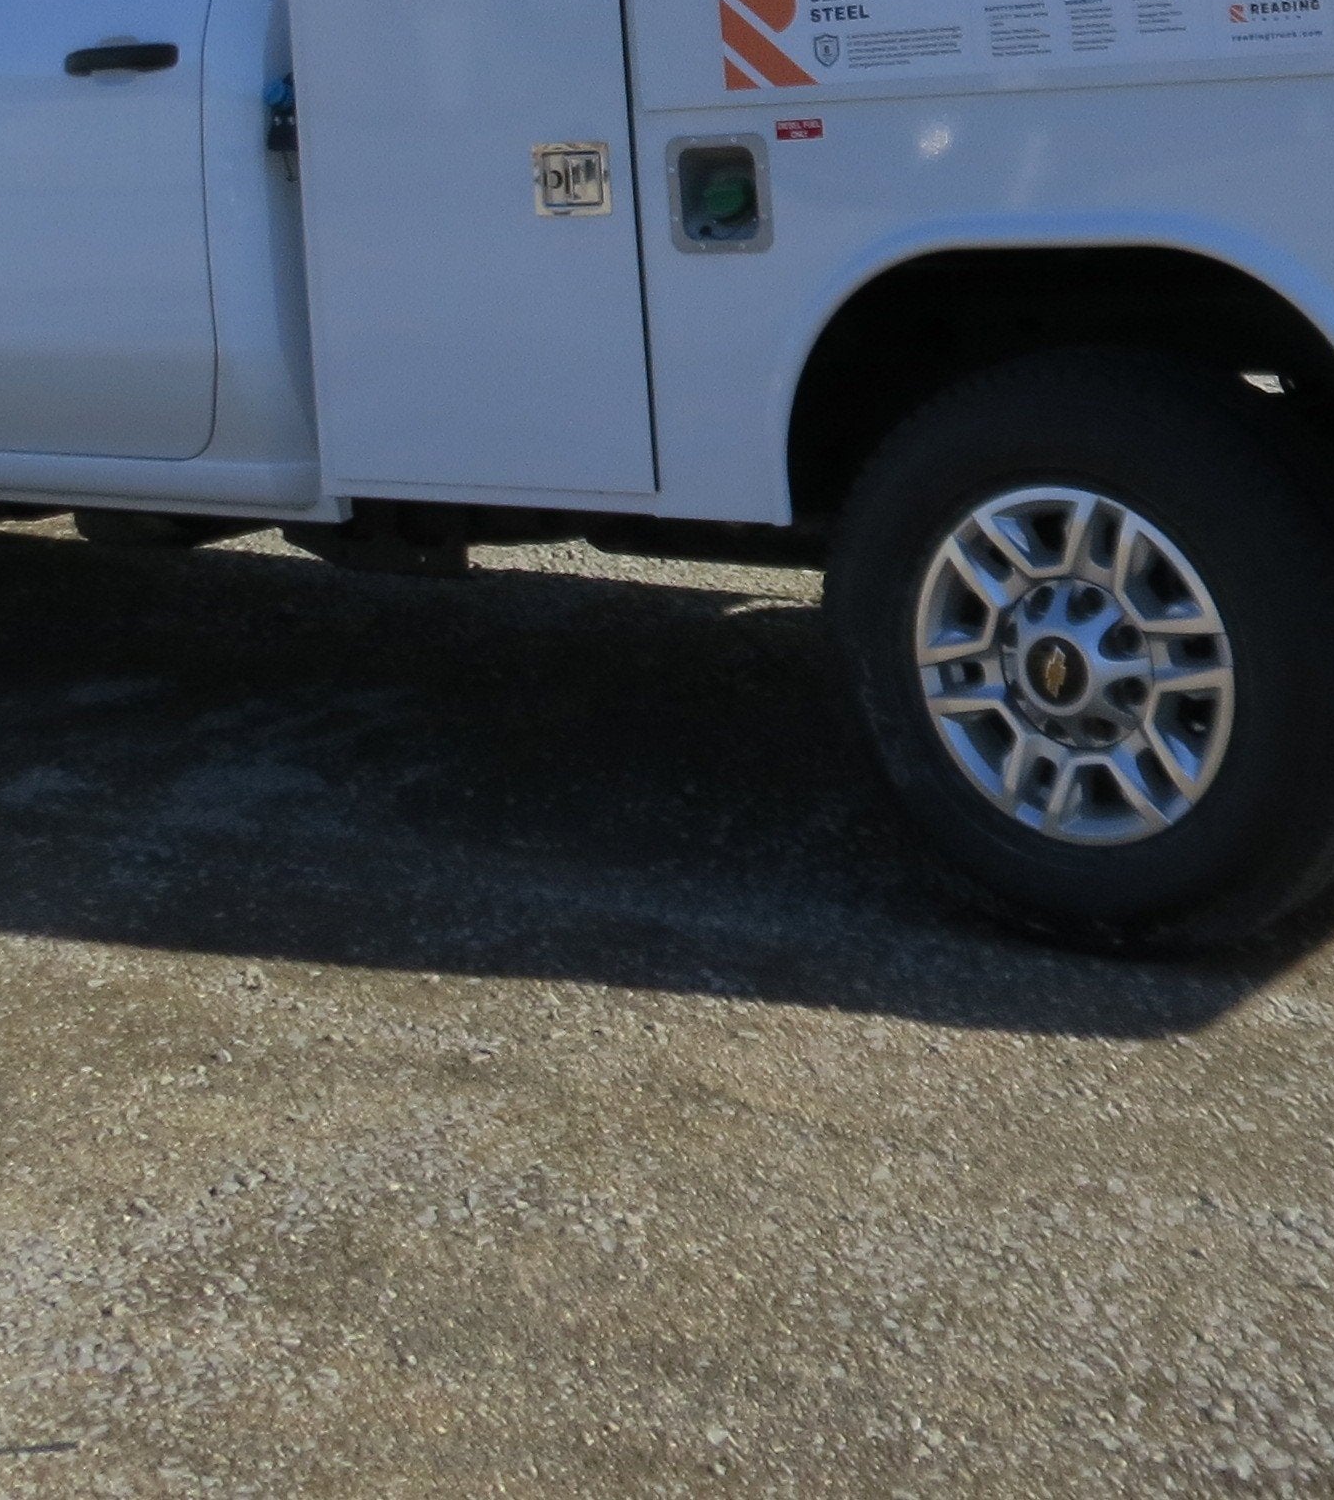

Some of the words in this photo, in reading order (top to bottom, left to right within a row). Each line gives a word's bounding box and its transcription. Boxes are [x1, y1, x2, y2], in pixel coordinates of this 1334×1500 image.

[810, 4, 871, 23] STEEL
[1250, 0, 1320, 15] READING
[777, 121, 801, 130] DIESEL
[803, 120, 821, 129] FUEL
